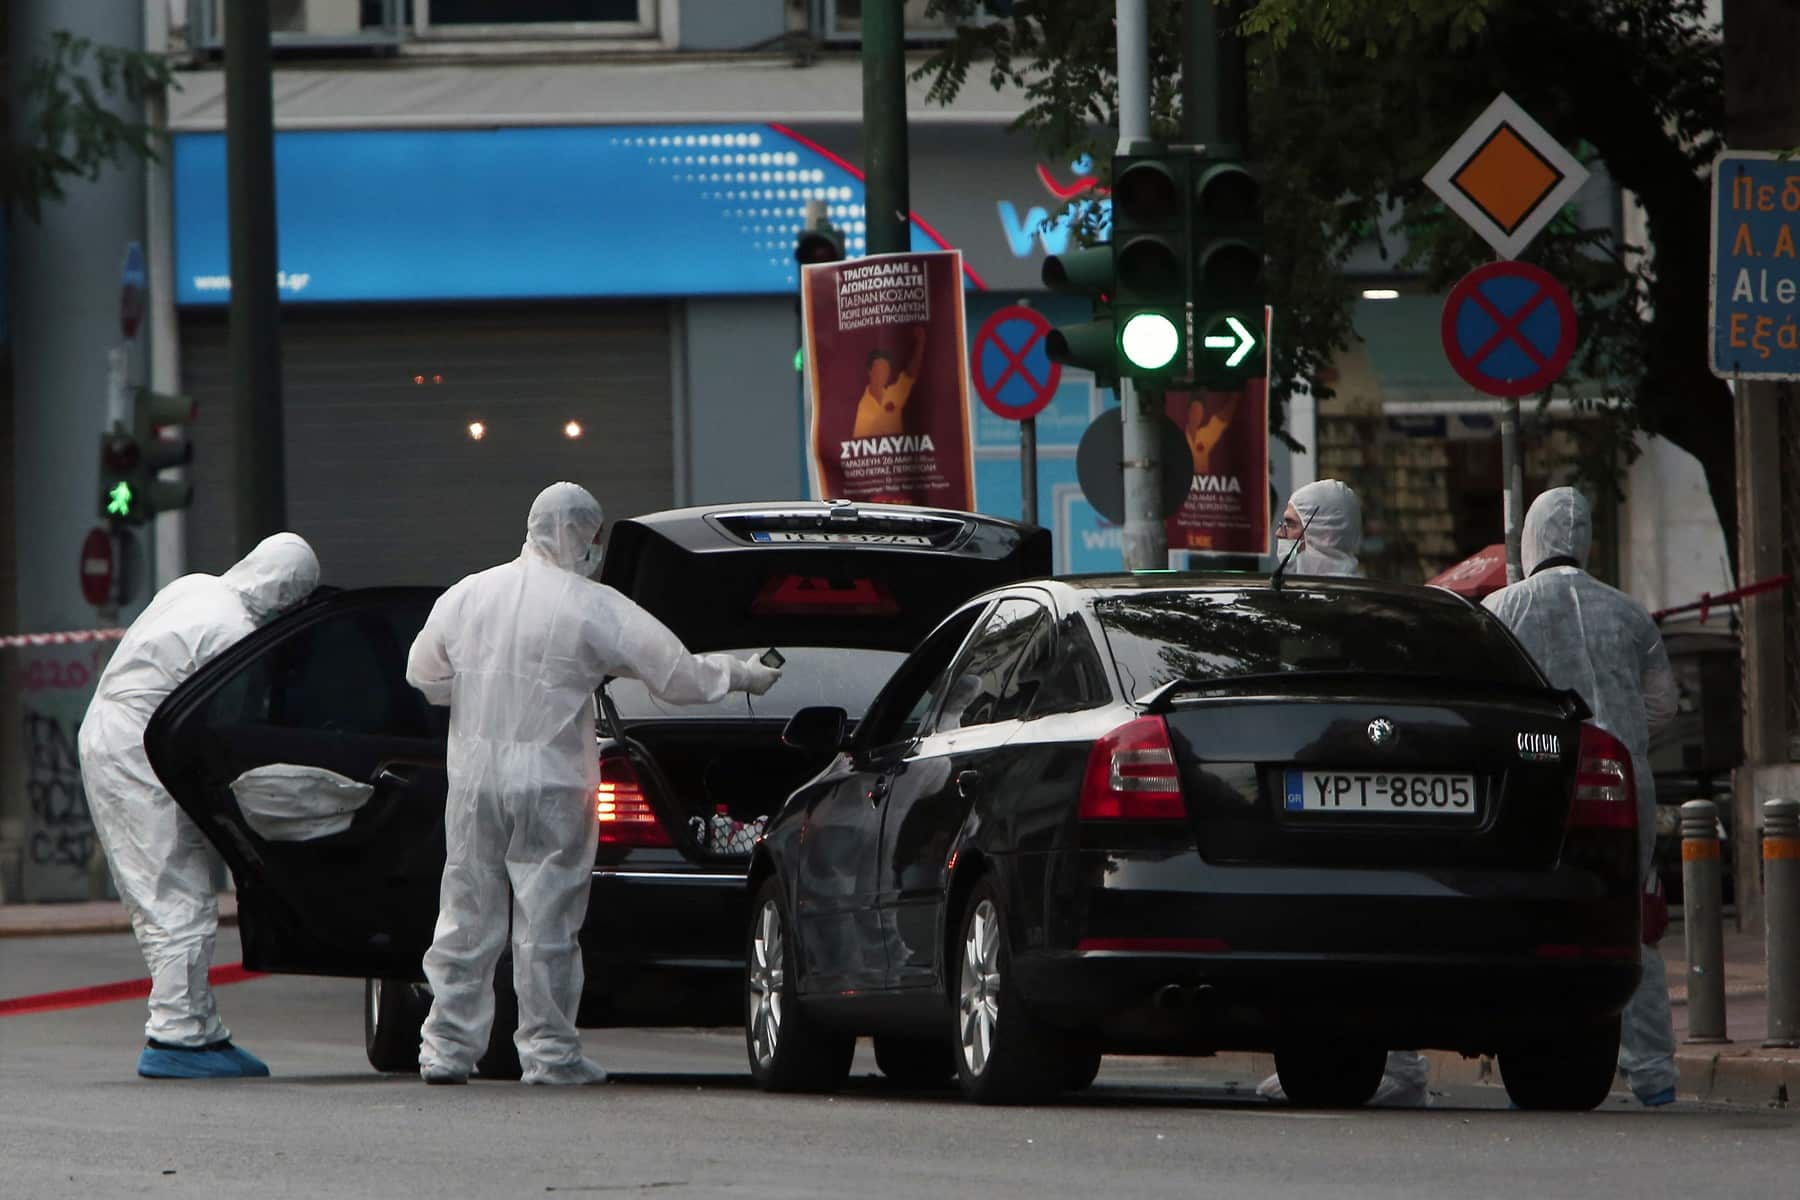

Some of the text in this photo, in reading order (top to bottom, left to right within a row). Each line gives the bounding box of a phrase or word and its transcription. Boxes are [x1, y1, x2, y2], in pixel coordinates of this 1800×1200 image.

[1732, 175, 1800, 212] Πεδ
[843, 263, 910, 281] ΤΡΑΓΟΥΔΑΜΕ
[840, 274, 924, 295] ΑΓΩΝΙΖΟΜΑΣΤΕ
[880, 287, 925, 302] ΚΟΣΜΟ
[1732, 267, 1797, 304] Ale
[1730, 312, 1800, 360] Εξά
[841, 435, 935, 459] ΣΥΝΑΥΛΙΑ
[1190, 475, 1241, 493] ΑΥΛΙΑ
[1288, 793, 1302, 804] GR
